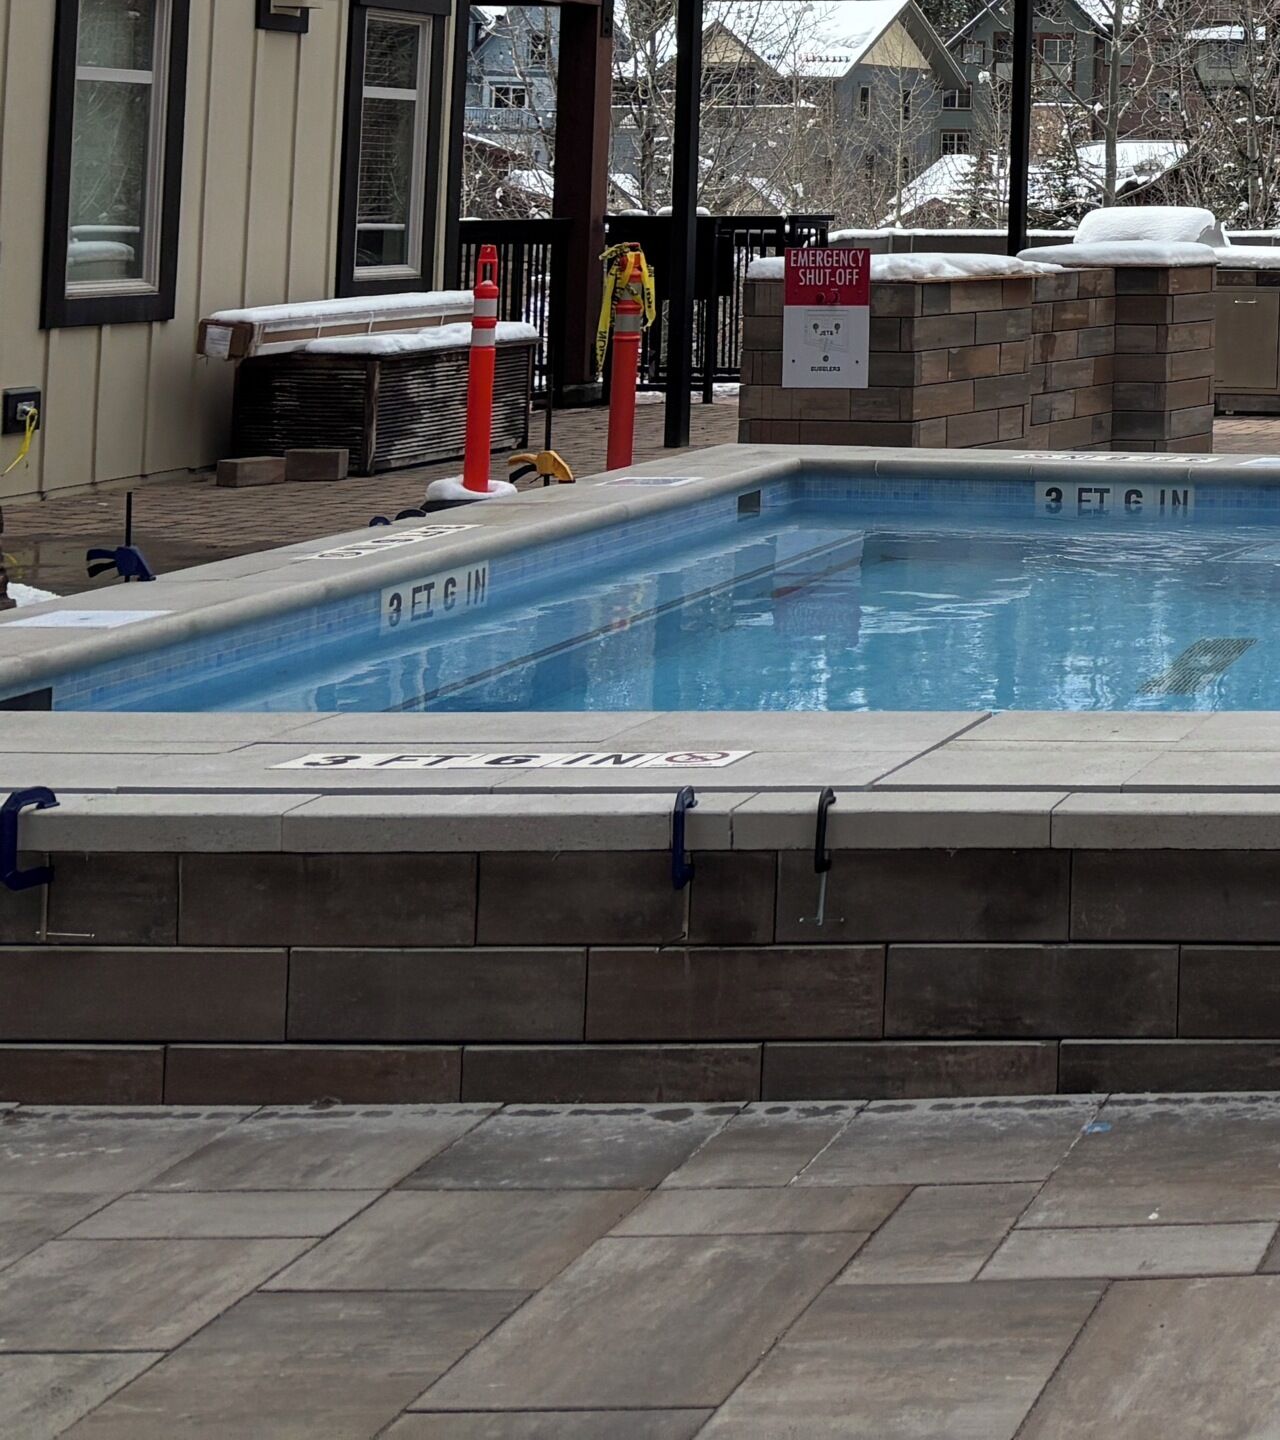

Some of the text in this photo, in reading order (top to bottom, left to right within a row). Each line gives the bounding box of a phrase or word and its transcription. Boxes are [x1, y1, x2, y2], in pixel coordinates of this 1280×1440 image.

[790, 250, 865, 267] EMERGENCY
[799, 269, 860, 286] SHUT-OFF
[1045, 487, 1063, 506] 3
[1160, 489, 1188, 508] IN
[389, 592, 402, 615] 3
[467, 568, 486, 596] IN
[304, 754, 645, 766] 3 FT 6 IN
